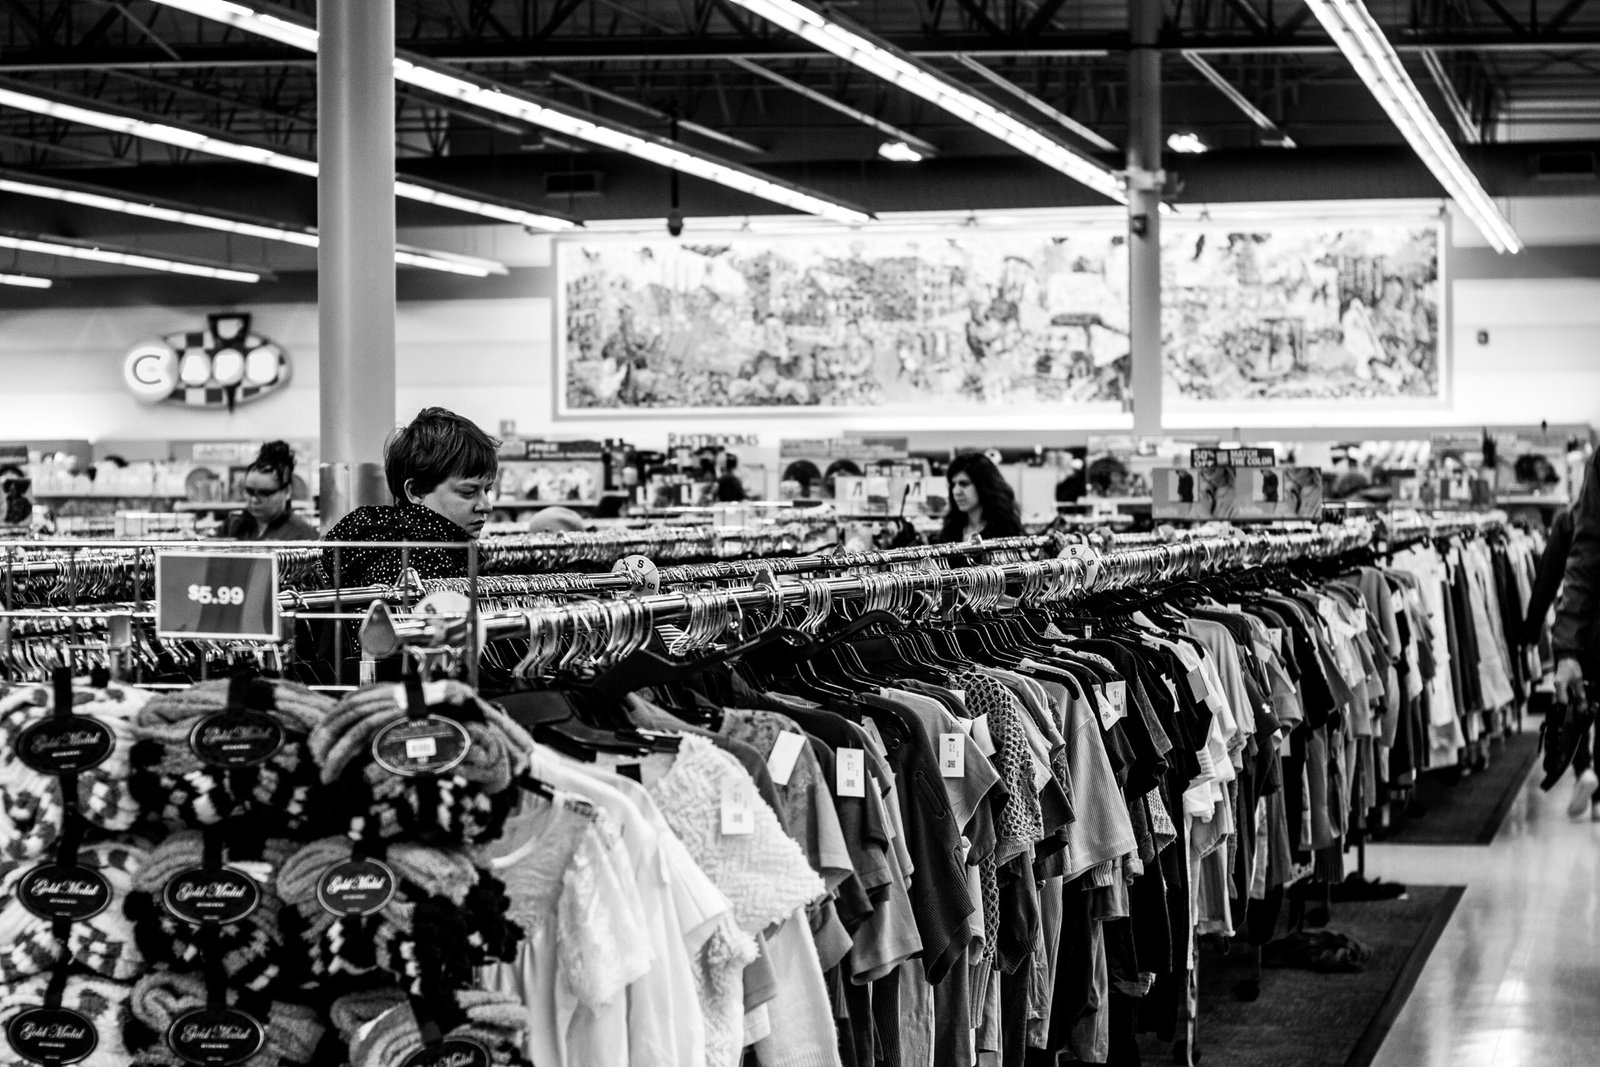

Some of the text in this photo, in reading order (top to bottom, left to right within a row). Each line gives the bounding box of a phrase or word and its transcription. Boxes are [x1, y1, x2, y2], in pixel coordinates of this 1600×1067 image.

[667, 432, 759, 447] RESTROOMS
[1230, 449, 1258, 457] MATCH
[1231, 457, 1245, 466] THE
[1247, 456, 1273, 466] COLOR
[637, 559, 645, 569] S
[187, 584, 244, 605] $5.99
